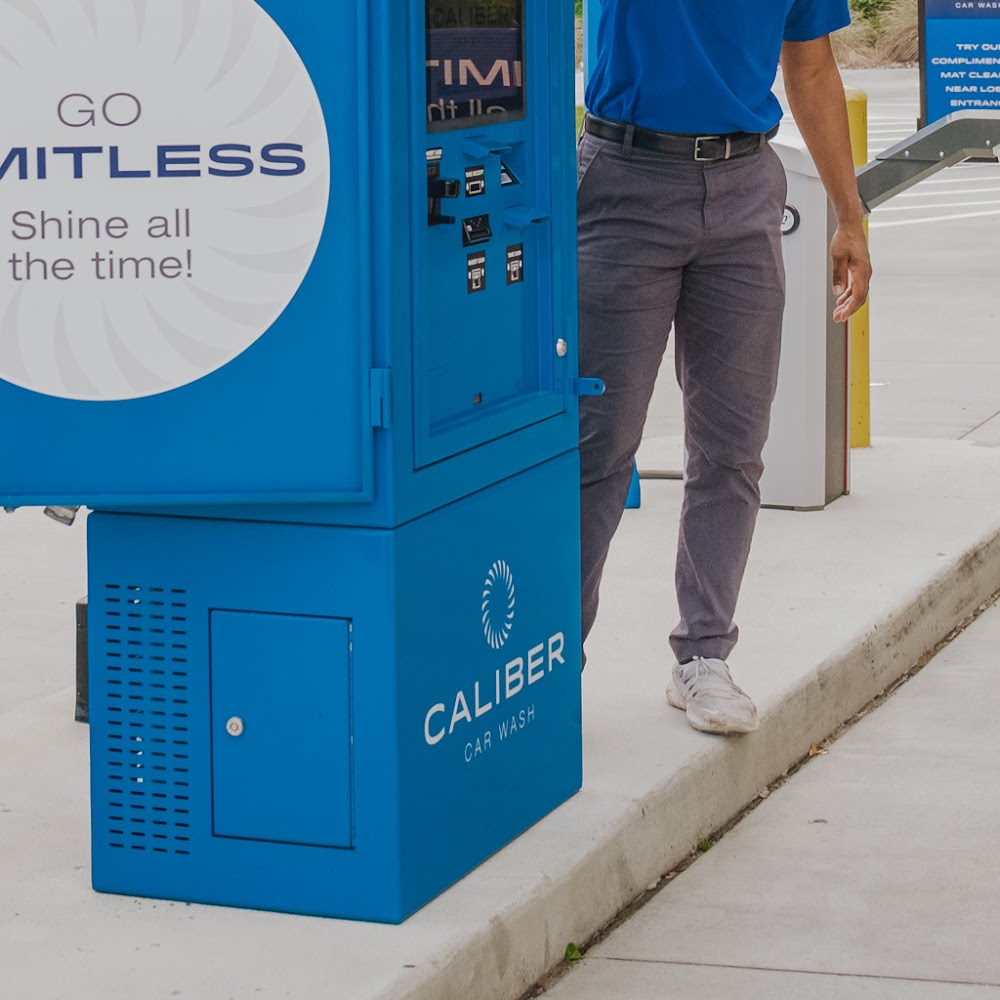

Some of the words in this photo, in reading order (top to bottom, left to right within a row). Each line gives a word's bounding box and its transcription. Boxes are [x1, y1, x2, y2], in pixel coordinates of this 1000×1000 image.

[956, 43, 979, 51] TRY
[940, 71, 966, 79] MAT
[945, 85, 977, 93] NEAR
[57, 92, 141, 127] GO
[11, 209, 129, 240] Shine
[147, 207, 191, 238] all
[8, 251, 75, 281] the
[91, 248, 193, 279] time!
[424, 631, 565, 745] CALIBER
[464, 731, 491, 762] CAR
[498, 704, 535, 741] WASH
